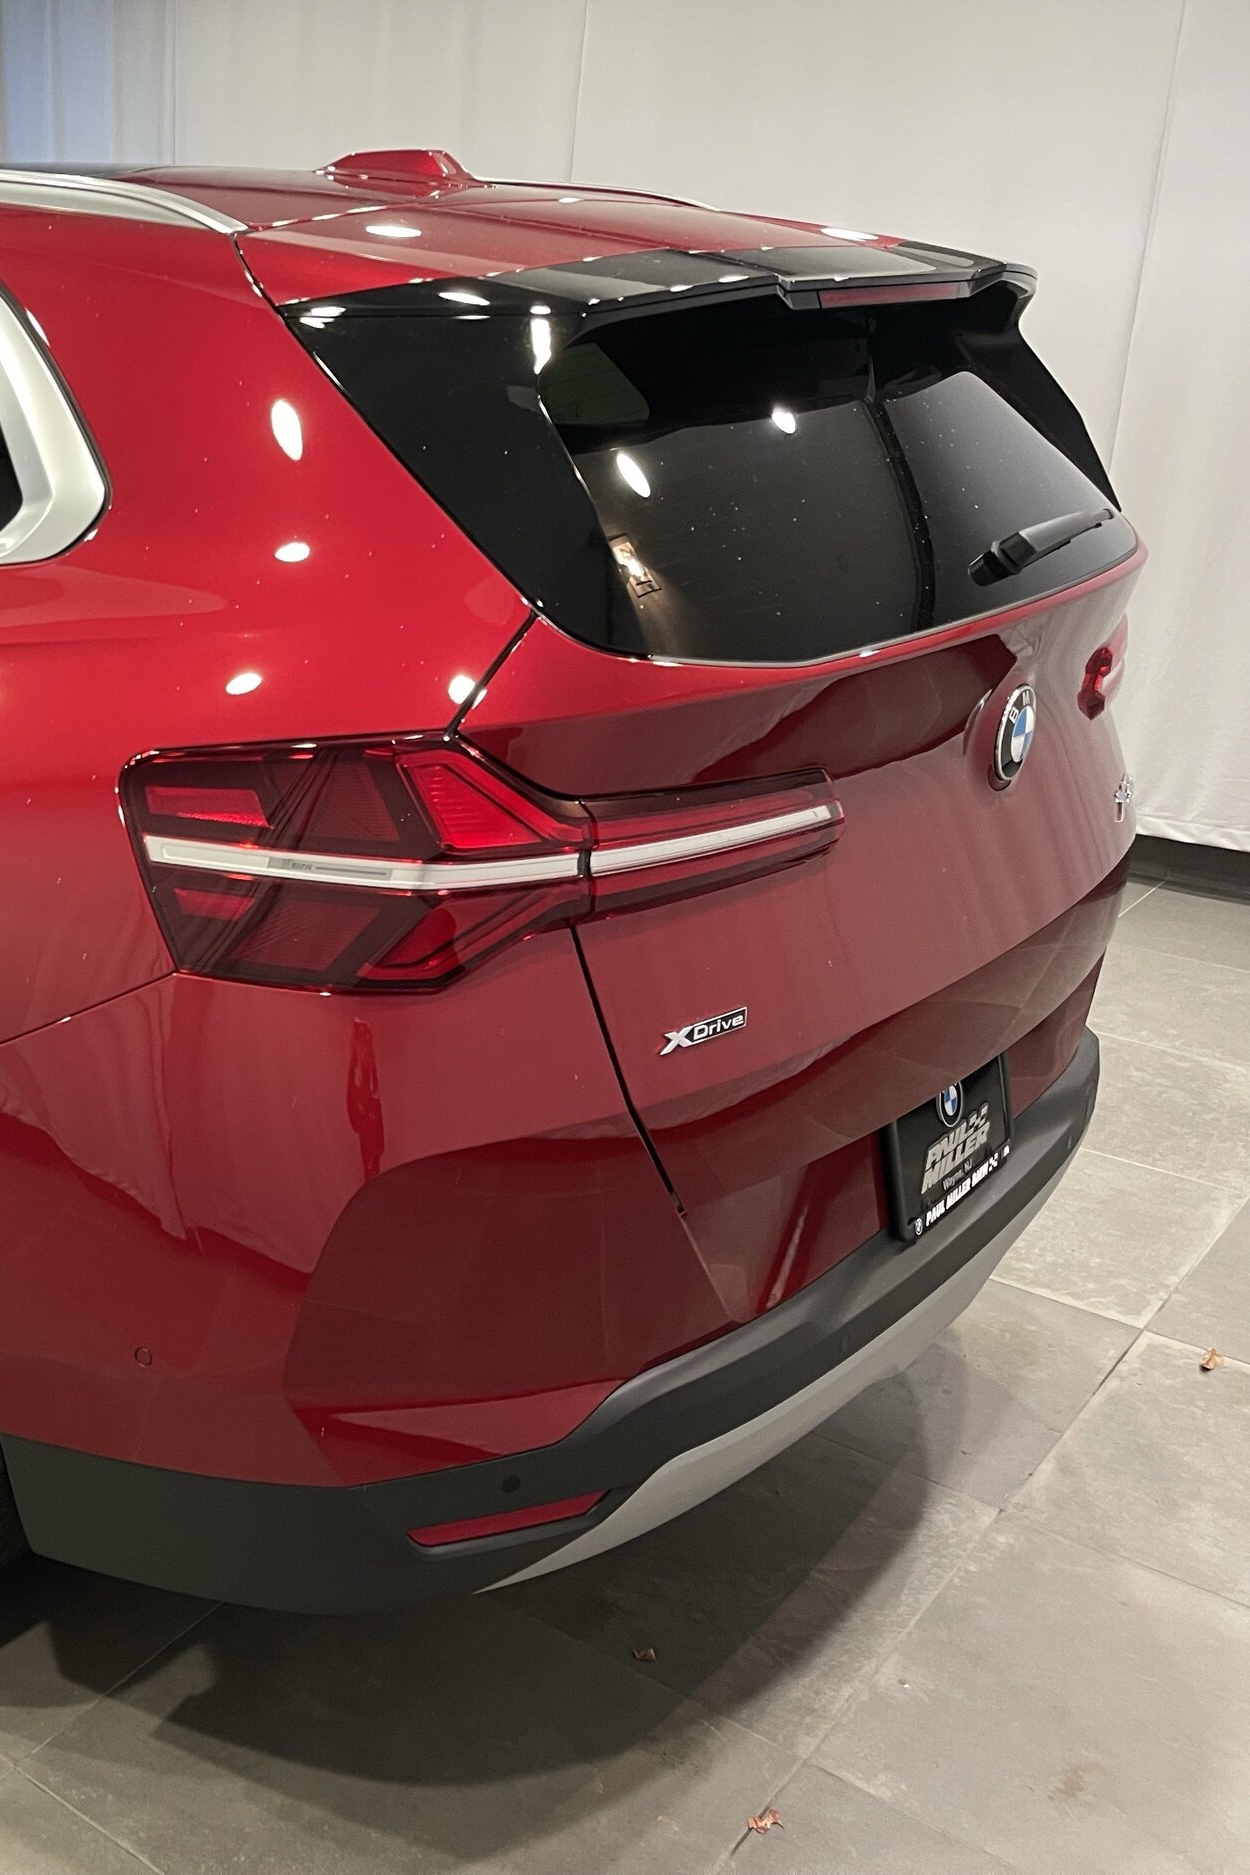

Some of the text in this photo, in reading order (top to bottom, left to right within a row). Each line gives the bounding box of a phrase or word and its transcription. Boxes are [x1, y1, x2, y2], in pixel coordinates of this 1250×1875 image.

[921, 1122, 990, 1195] MILLER
[925, 1121, 974, 1171] PAUL
[926, 1199, 946, 1227] PAUL
[946, 1177, 971, 1210] MILLER
